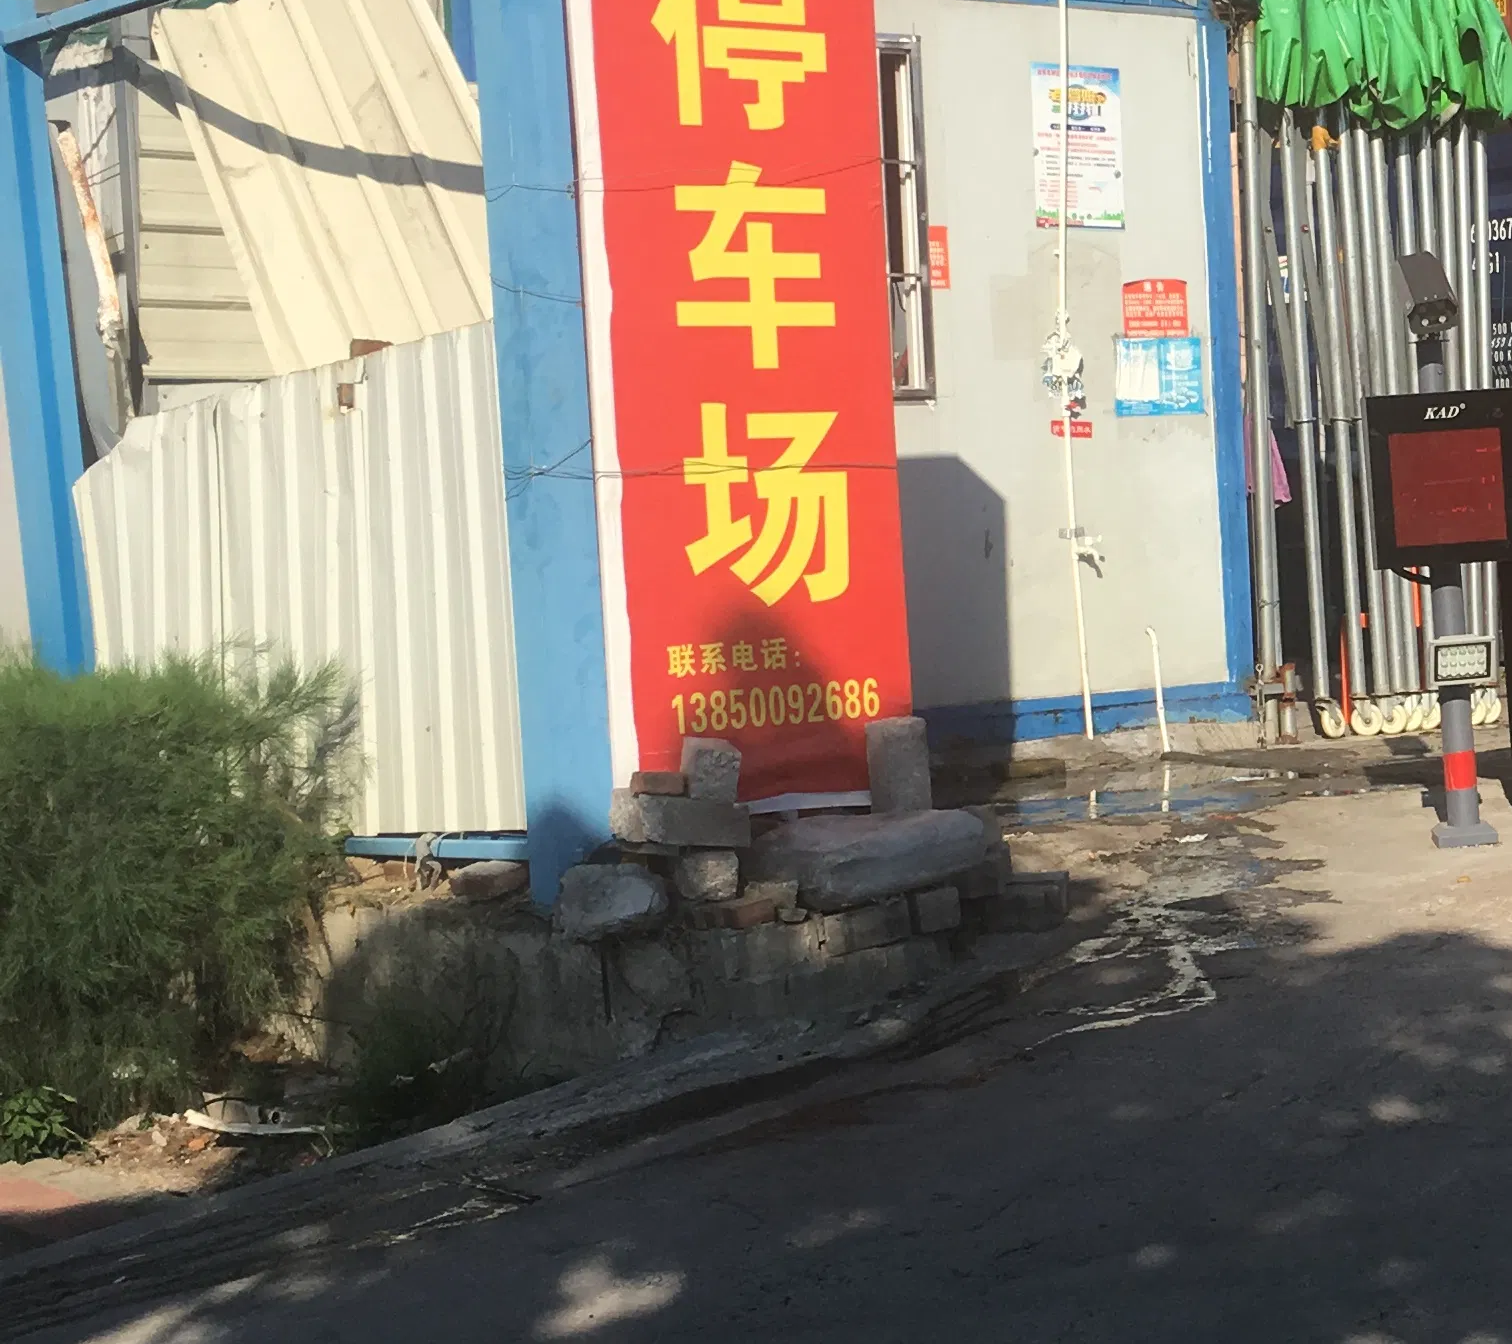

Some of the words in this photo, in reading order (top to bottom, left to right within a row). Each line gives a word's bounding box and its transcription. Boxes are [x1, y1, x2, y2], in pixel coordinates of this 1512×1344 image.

[666, 637, 802, 679] 联系电话:
[671, 676, 881, 735] 13850092686
